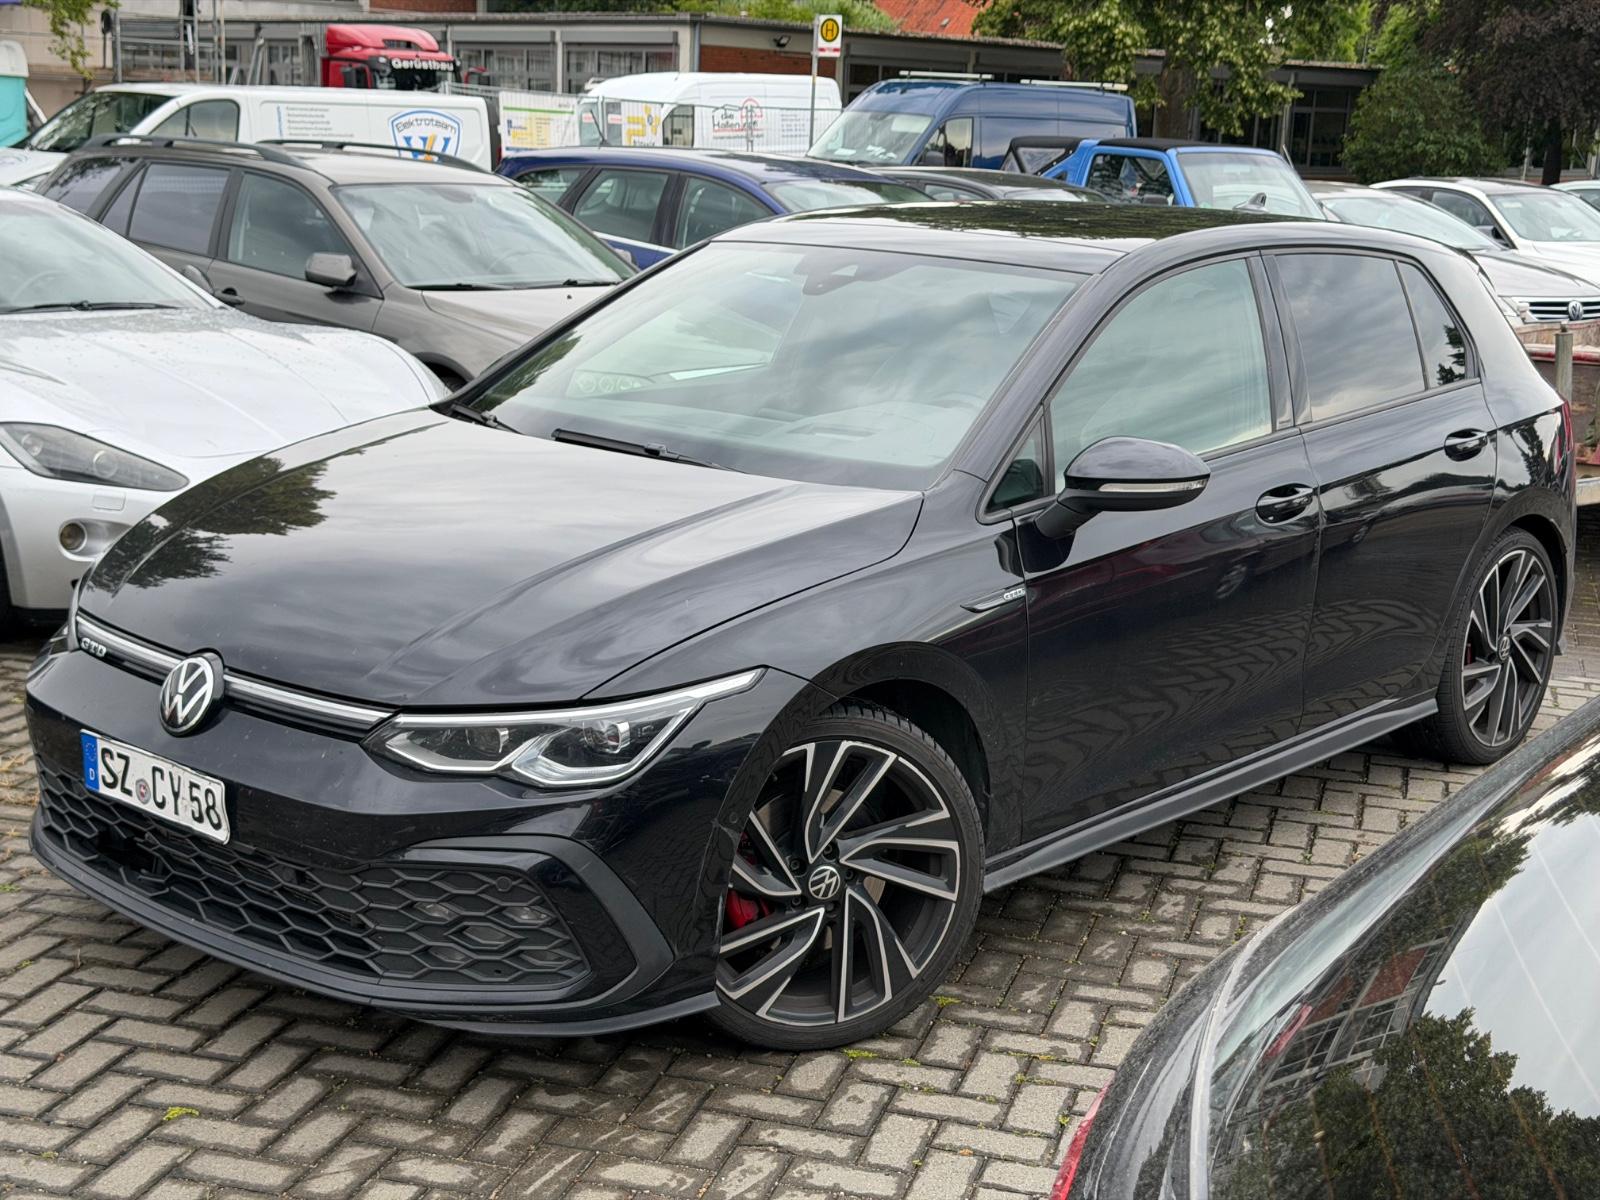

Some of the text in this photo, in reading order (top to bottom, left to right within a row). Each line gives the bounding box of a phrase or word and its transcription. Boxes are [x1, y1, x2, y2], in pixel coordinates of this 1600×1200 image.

[81, 637, 107, 658] GTD
[88, 767, 96, 781] D
[101, 748, 222, 831] SZ CY 58
